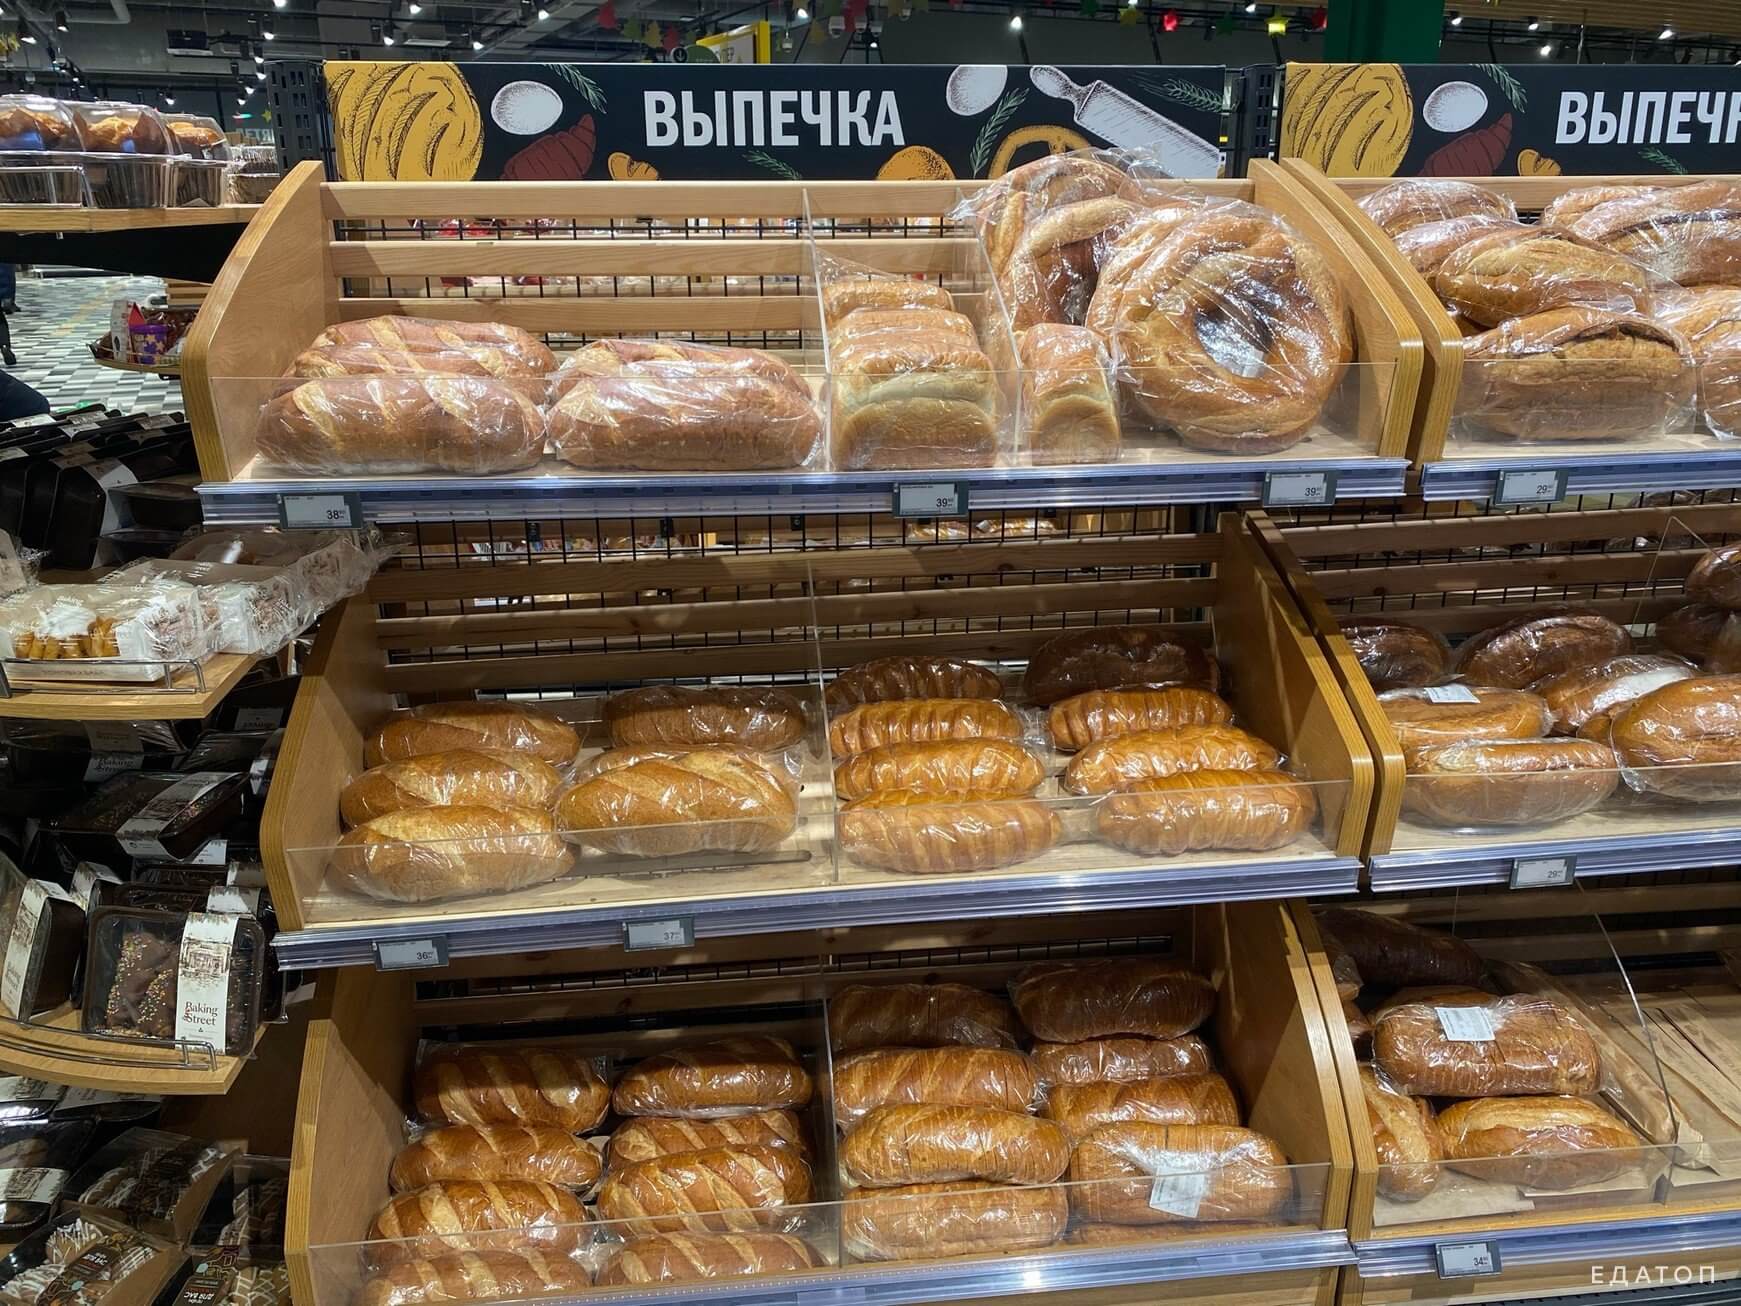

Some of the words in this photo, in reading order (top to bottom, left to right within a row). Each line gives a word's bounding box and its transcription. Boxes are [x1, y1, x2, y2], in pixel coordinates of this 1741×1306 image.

[643, 90, 906, 147] ВЫПЕЧКА
[184, 1001, 219, 1018] Baking
[183, 1012, 217, 1026] Street
